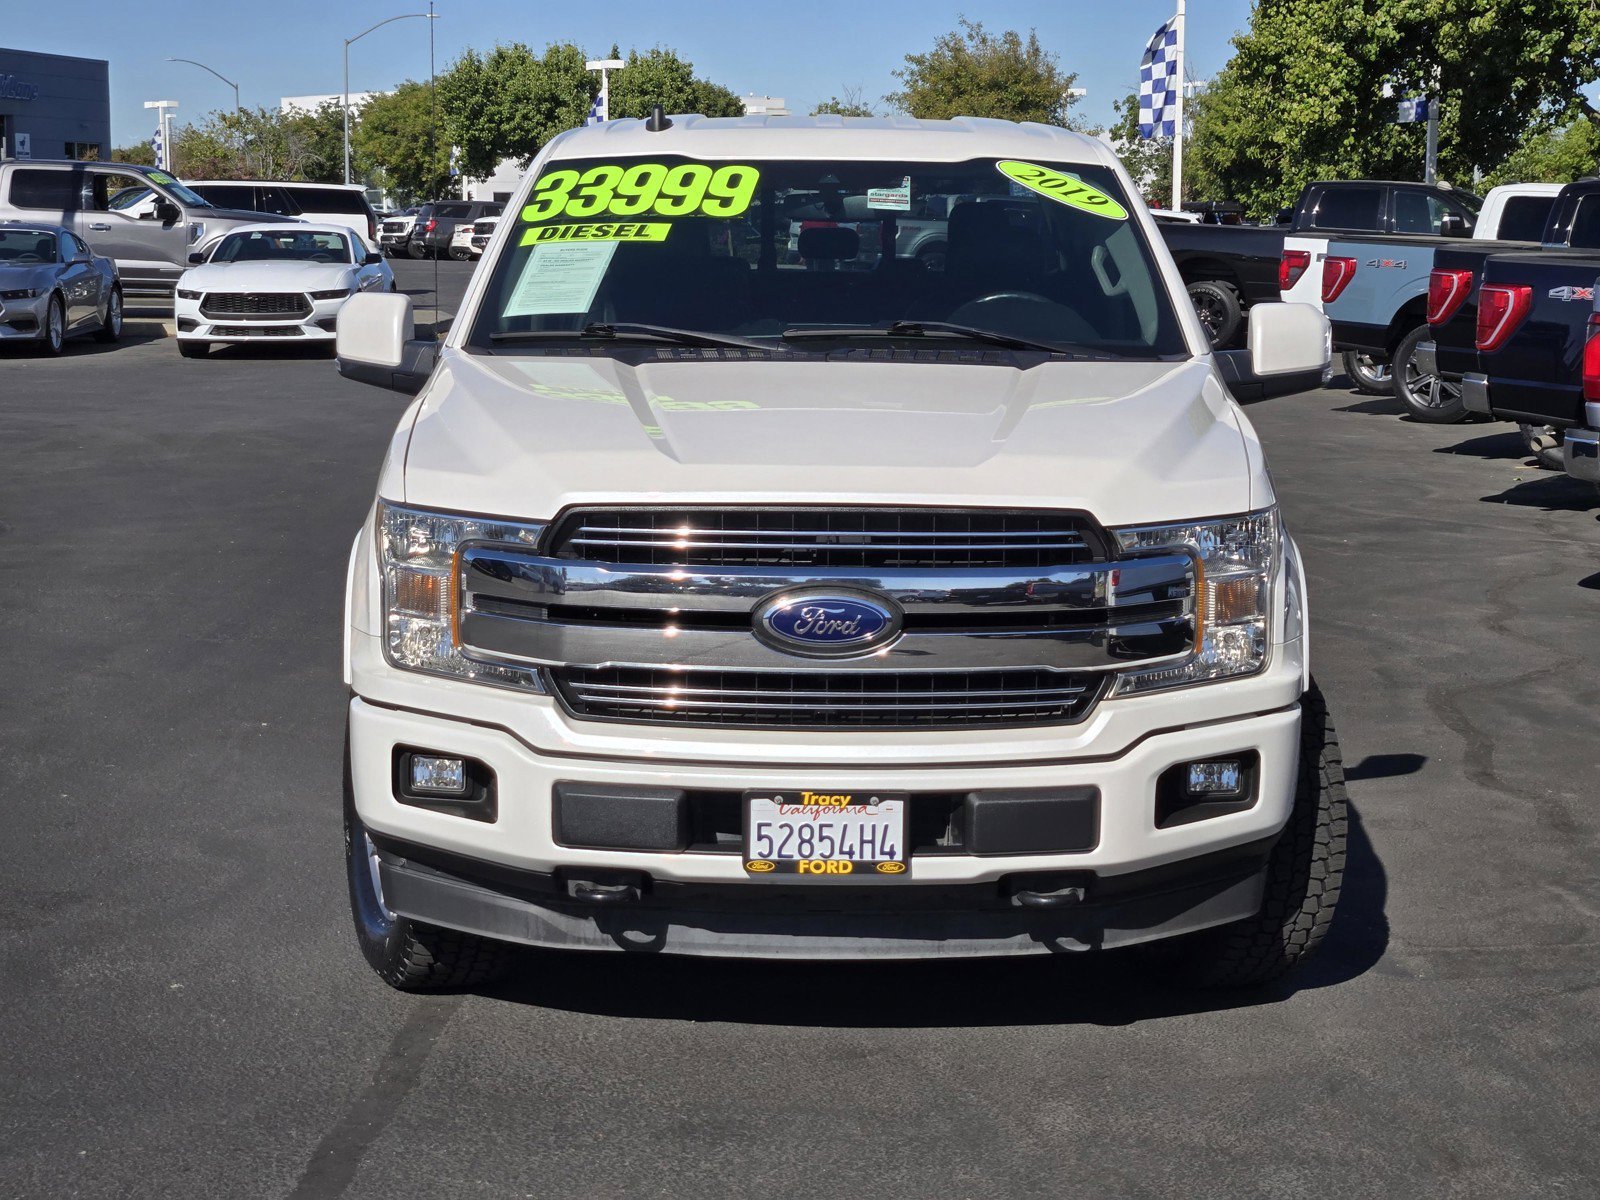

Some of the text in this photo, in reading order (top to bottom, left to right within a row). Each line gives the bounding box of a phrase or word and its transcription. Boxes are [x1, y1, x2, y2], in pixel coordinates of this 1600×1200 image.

[521, 163, 760, 222] 33999
[1013, 169, 1109, 205] 2019
[536, 224, 652, 242] DIESEL
[793, 606, 862, 635] Ford
[779, 802, 879, 821] California
[801, 792, 852, 808] Tracy
[756, 822, 897, 860] 52854H4
[799, 860, 853, 874] FORD
